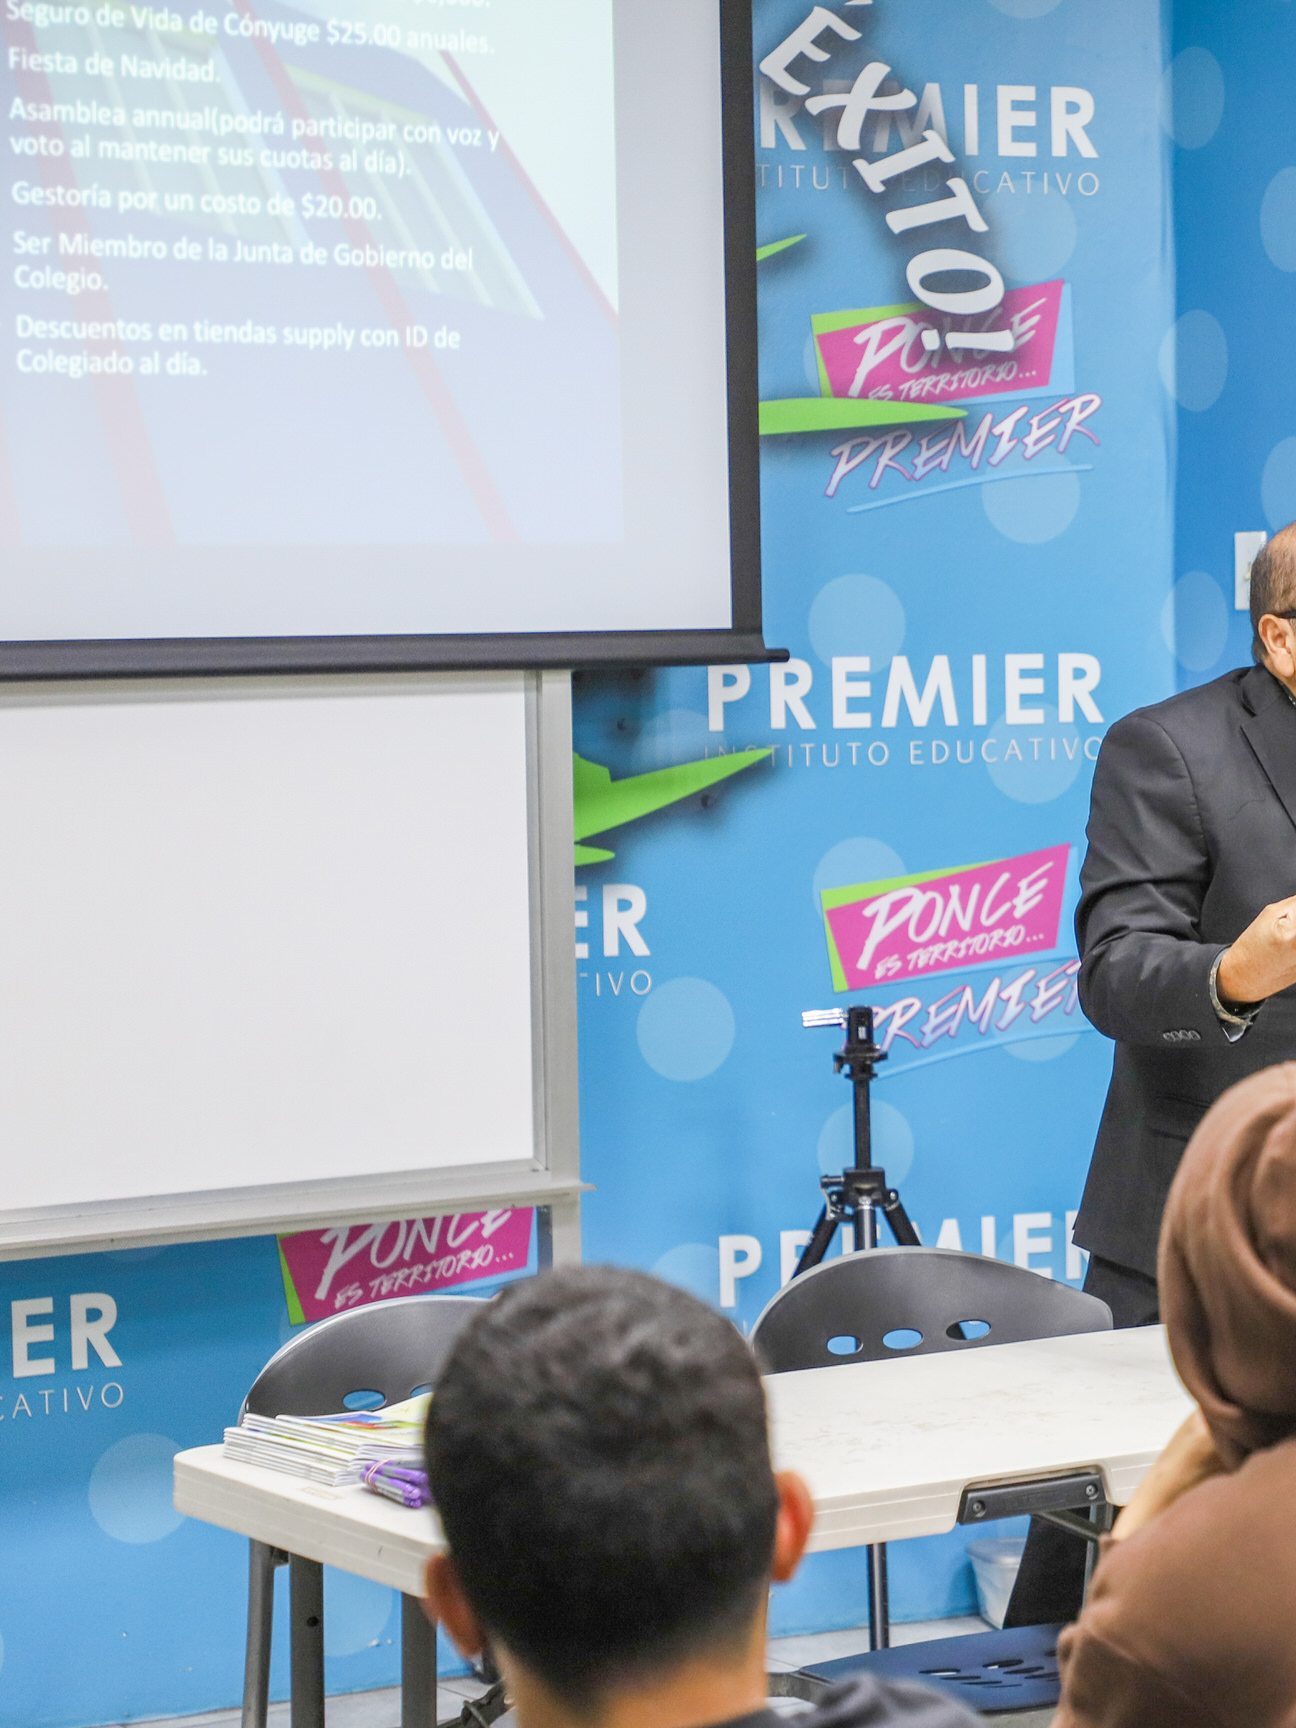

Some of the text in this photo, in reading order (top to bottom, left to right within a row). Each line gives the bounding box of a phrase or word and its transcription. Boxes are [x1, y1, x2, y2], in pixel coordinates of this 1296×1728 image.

[6, 0, 495, 54] Seguro de Vida de Cónyuge $25.00 anuales.
[8, 47, 221, 83] Fiesta de Navidad.
[9, 97, 127, 127] Asamblea
[291, 115, 397, 144] participar
[402, 124, 441, 143] con
[446, 127, 482, 146] voz
[487, 131, 500, 152] y
[759, 77, 1099, 158] REMIER
[9, 133, 412, 180] voto al mantener sus cuotas al día).
[11, 180, 383, 220] Gestoría por un costo de $20.00.
[13, 230, 473, 270] Ser Miembro de la Junta de Gobierno del
[13, 264, 109, 295] Colegio.
[16, 314, 461, 350] Descuentos en tiendas supply con ID de
[16, 348, 208, 378] Colegiado al día.
[824, 393, 1102, 498] PREMIER
[707, 653, 1105, 732] PREMIER
[909, 737, 1101, 765] EDUCATIVO
[856, 861, 1054, 970] PONCE
[875, 954, 903, 980] ES
[333, 1282, 364, 1309] ES
[0, 1382, 124, 1420] ATIVO
